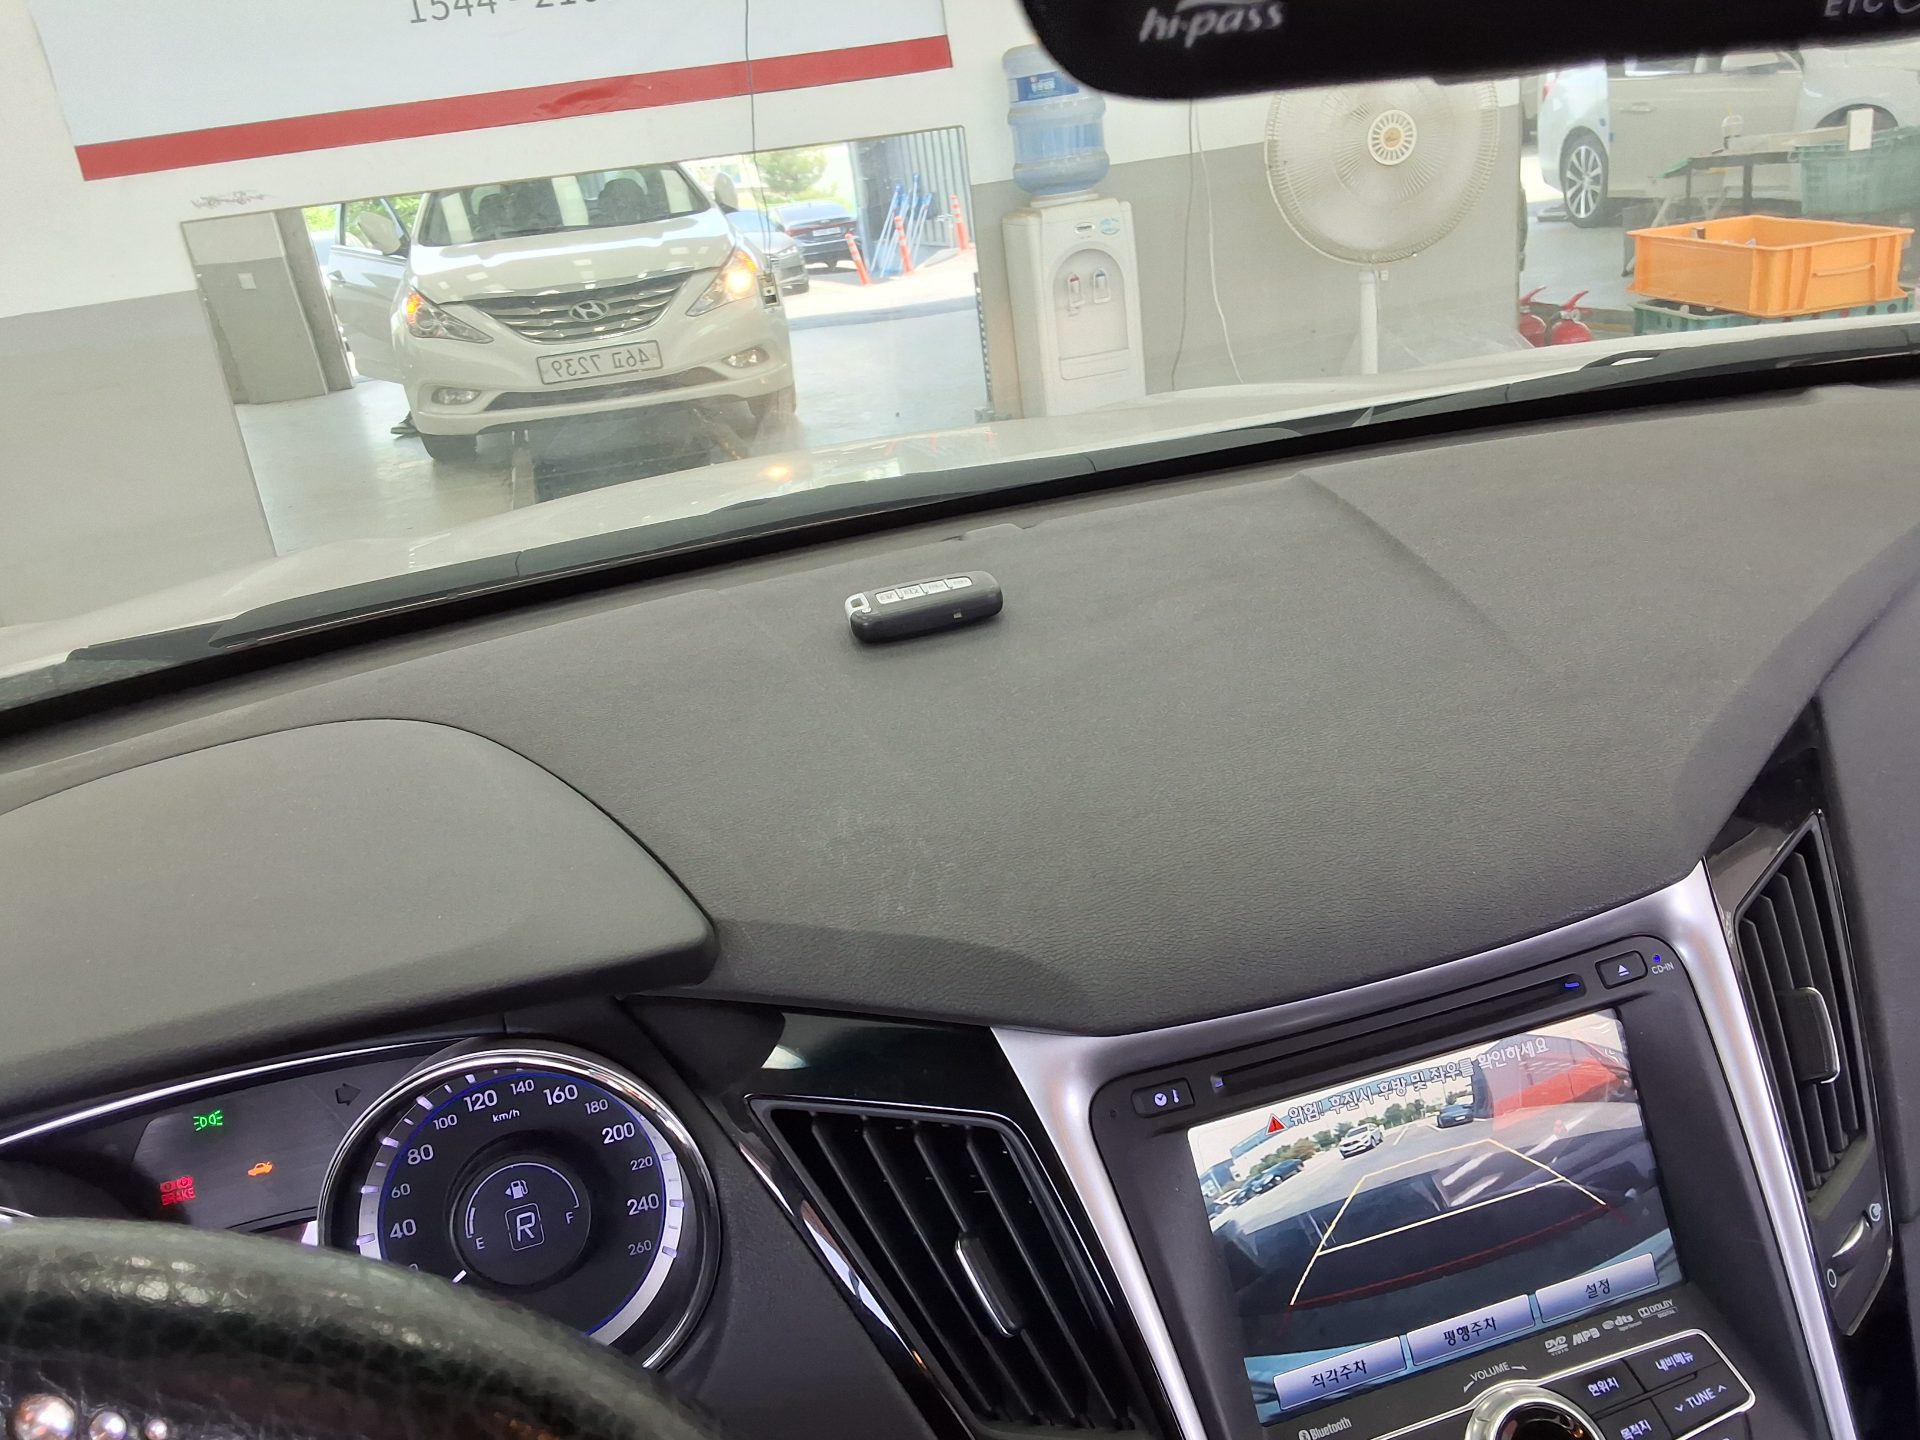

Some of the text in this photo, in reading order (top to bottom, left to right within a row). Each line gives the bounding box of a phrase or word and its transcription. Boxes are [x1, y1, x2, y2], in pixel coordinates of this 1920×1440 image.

[1651, 961, 1674, 974] CD-IN
[510, 1079, 534, 1095] 140
[1288, 1037, 1549, 1126] 위험! 후진시 후방 및 좌우를 확인하세요
[463, 1089, 497, 1111] 120
[543, 1084, 578, 1106] 160
[492, 1109, 520, 1122] km/h
[585, 1098, 608, 1114] 180
[433, 1114, 457, 1130] 100
[601, 1122, 635, 1144] 200
[406, 1144, 433, 1164] 80
[630, 1156, 652, 1170] 220
[391, 1183, 410, 1198] 60
[627, 1193, 659, 1215] 240
[516, 1211, 535, 1241] R
[565, 1211, 573, 1223] F
[389, 1218, 416, 1239] 40
[475, 1237, 485, 1250] E
[628, 1240, 651, 1255] 260
[1585, 1278, 1611, 1299] 설정
[1443, 1316, 1497, 1345] 평행주차
[1544, 1335, 1566, 1348] DVD
[1311, 1359, 1368, 1388] 직각주차
[1469, 1361, 1510, 1382] VOLUME
[1685, 1388, 1716, 1409] TUNE
[1309, 1417, 1352, 1440] Bluetooth
